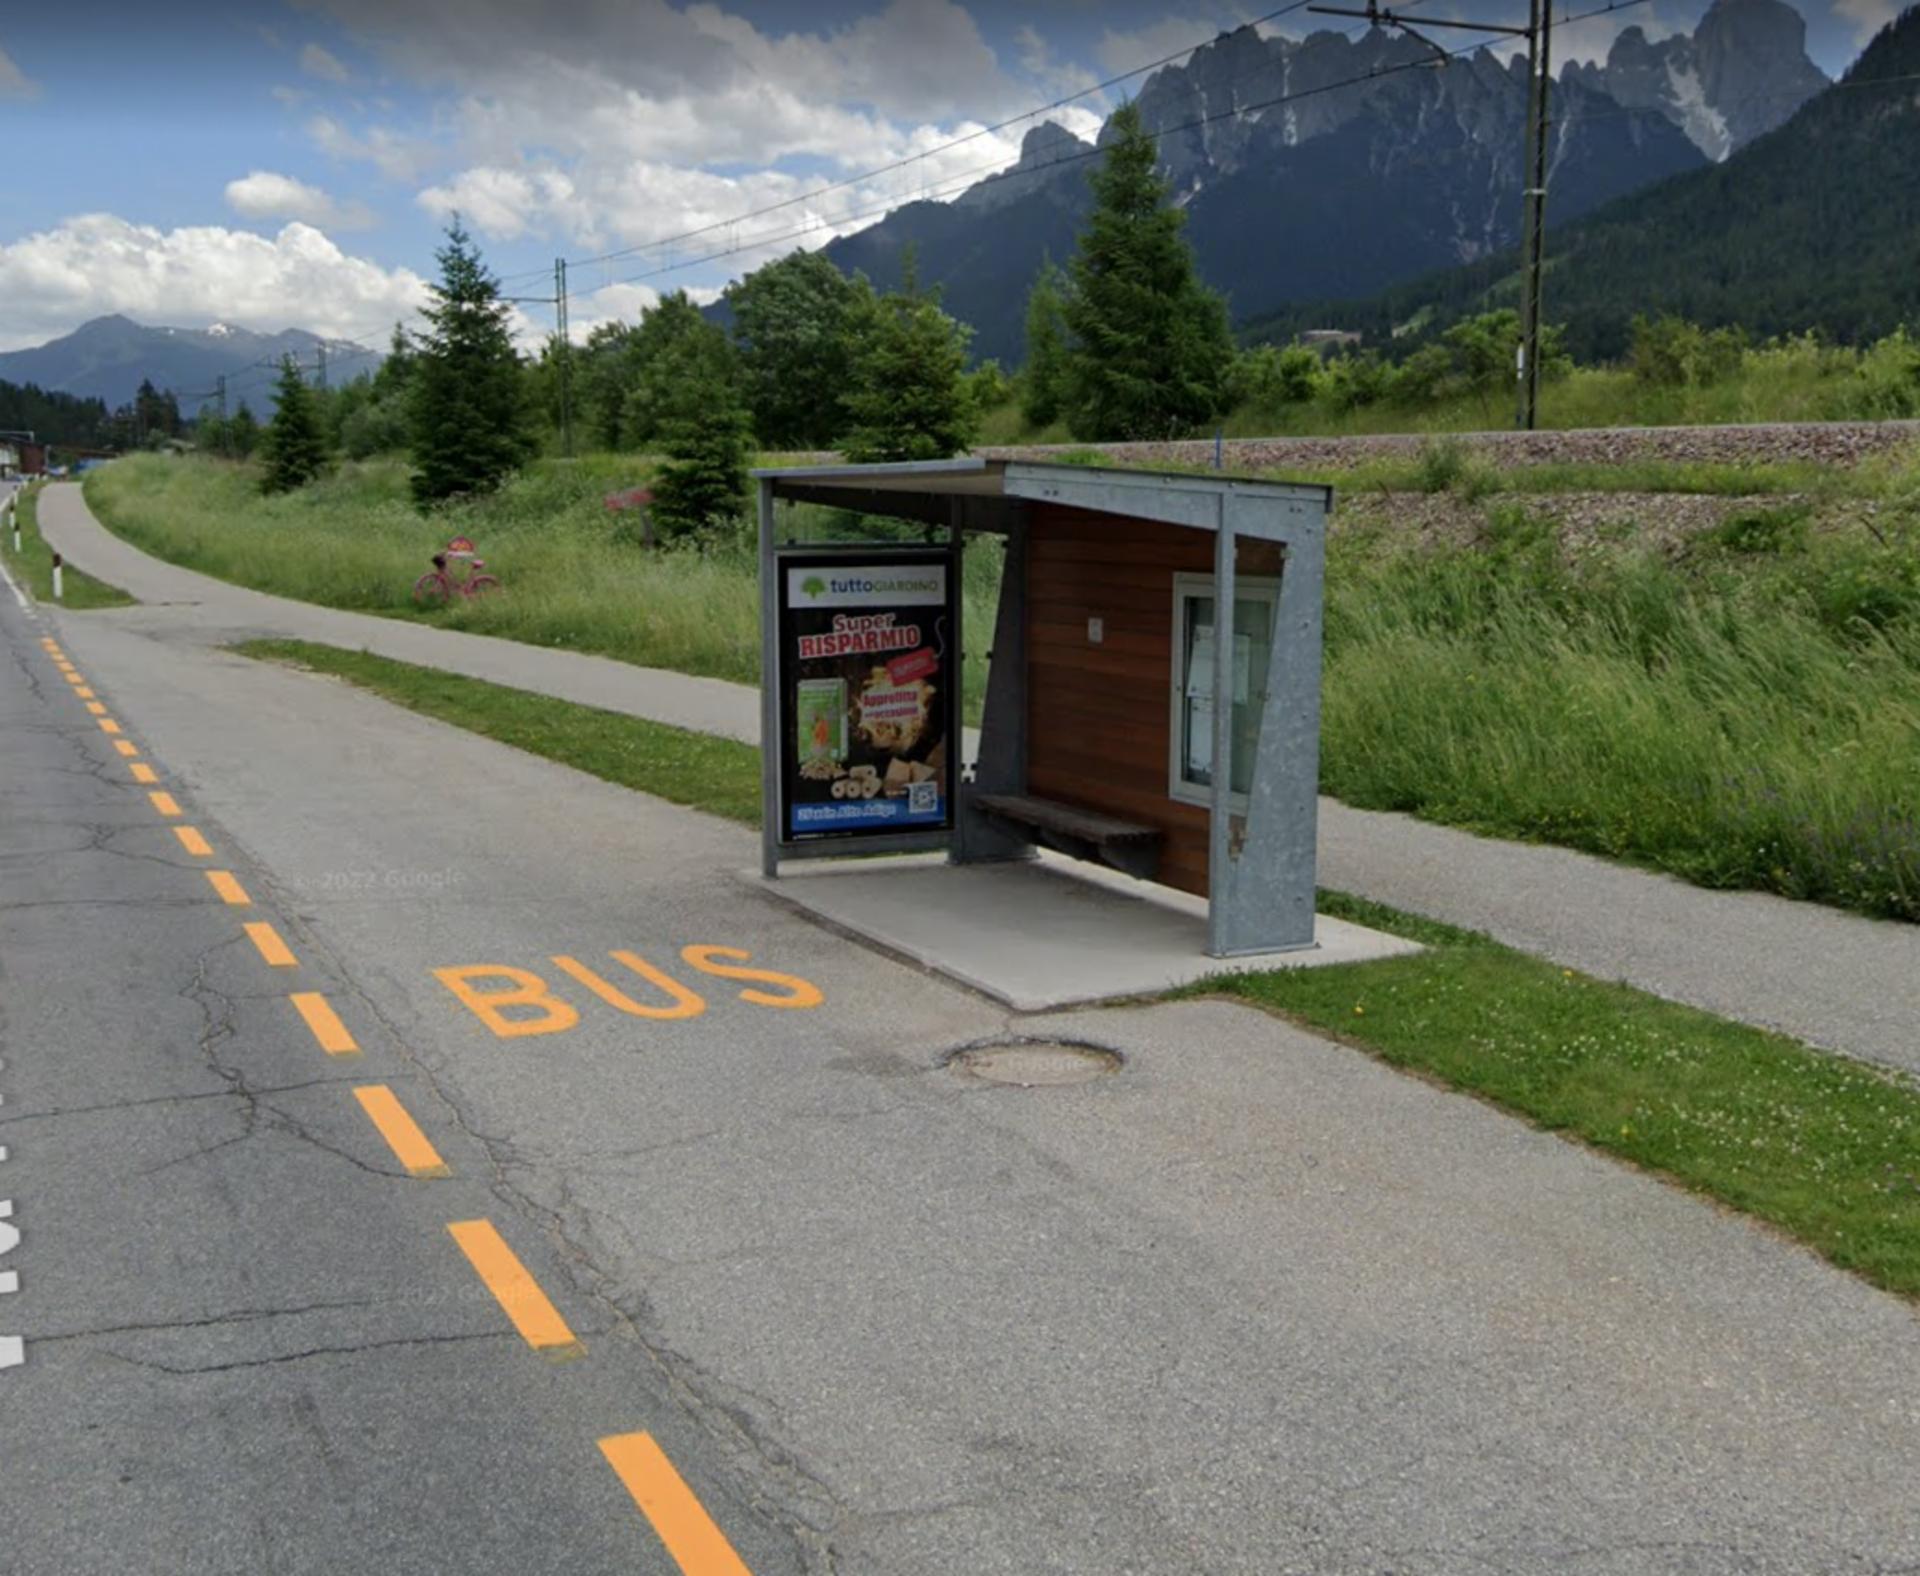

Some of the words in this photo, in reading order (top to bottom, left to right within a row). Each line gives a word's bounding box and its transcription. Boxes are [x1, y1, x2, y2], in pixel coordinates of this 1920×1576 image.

[833, 613, 895, 633] Super
[799, 625, 920, 659] RISPARMIO
[432, 944, 825, 1039] BUS
